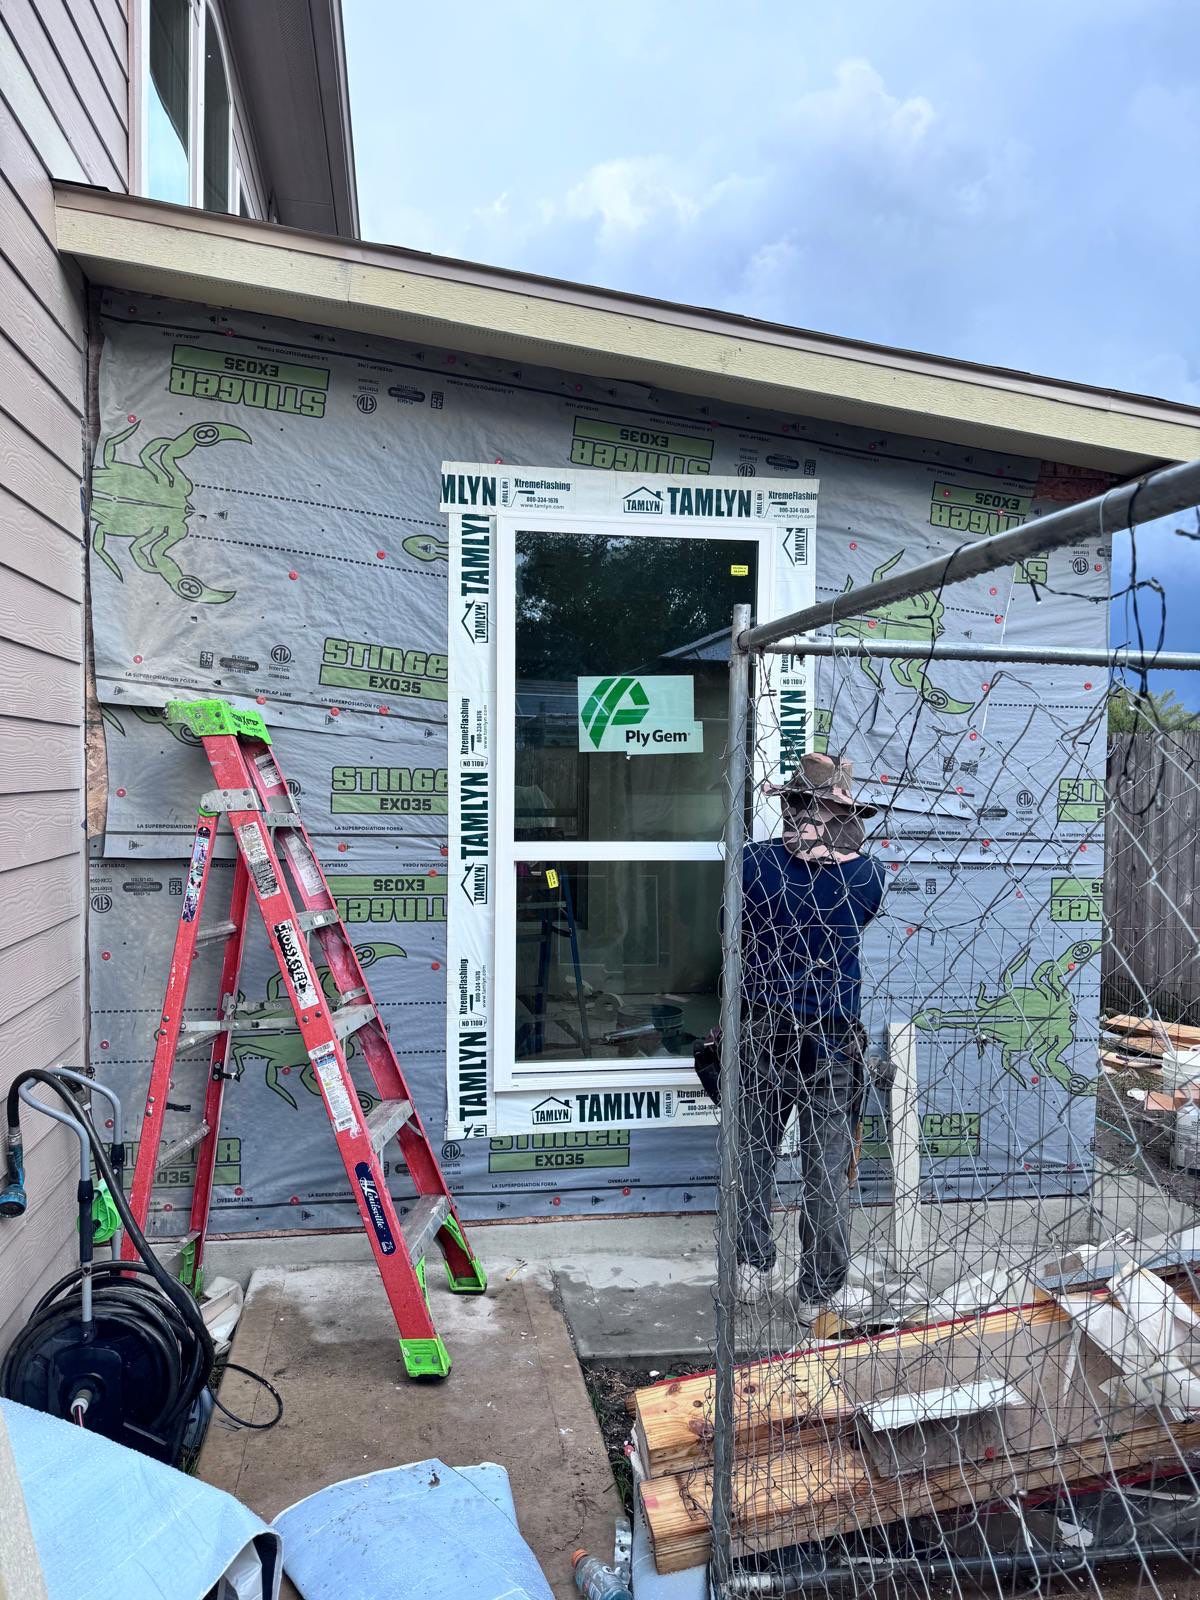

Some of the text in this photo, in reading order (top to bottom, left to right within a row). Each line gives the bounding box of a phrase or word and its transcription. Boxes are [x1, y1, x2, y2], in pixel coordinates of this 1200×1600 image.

[514, 478, 571, 491] XtremeFlashing
[627, 499, 660, 512] TAMLYN
[667, 487, 751, 518] TAMLYN
[475, 604, 485, 639] TAMLYN
[323, 637, 448, 679] STINGE
[255, 688, 277, 696] OVERLAP
[460, 698, 470, 755] XtremeFlashing
[626, 730, 688, 747] Ply Gem
[332, 766, 448, 792] STINGE
[460, 773, 489, 859] TAMLYN
[474, 865, 486, 904] TAMLYN
[459, 959, 469, 1015] XtremeFlashing
[459, 1031, 487, 1122] TAMLYN
[534, 1108, 570, 1123] TAMLYN
[576, 1091, 660, 1122] TAMLYN
